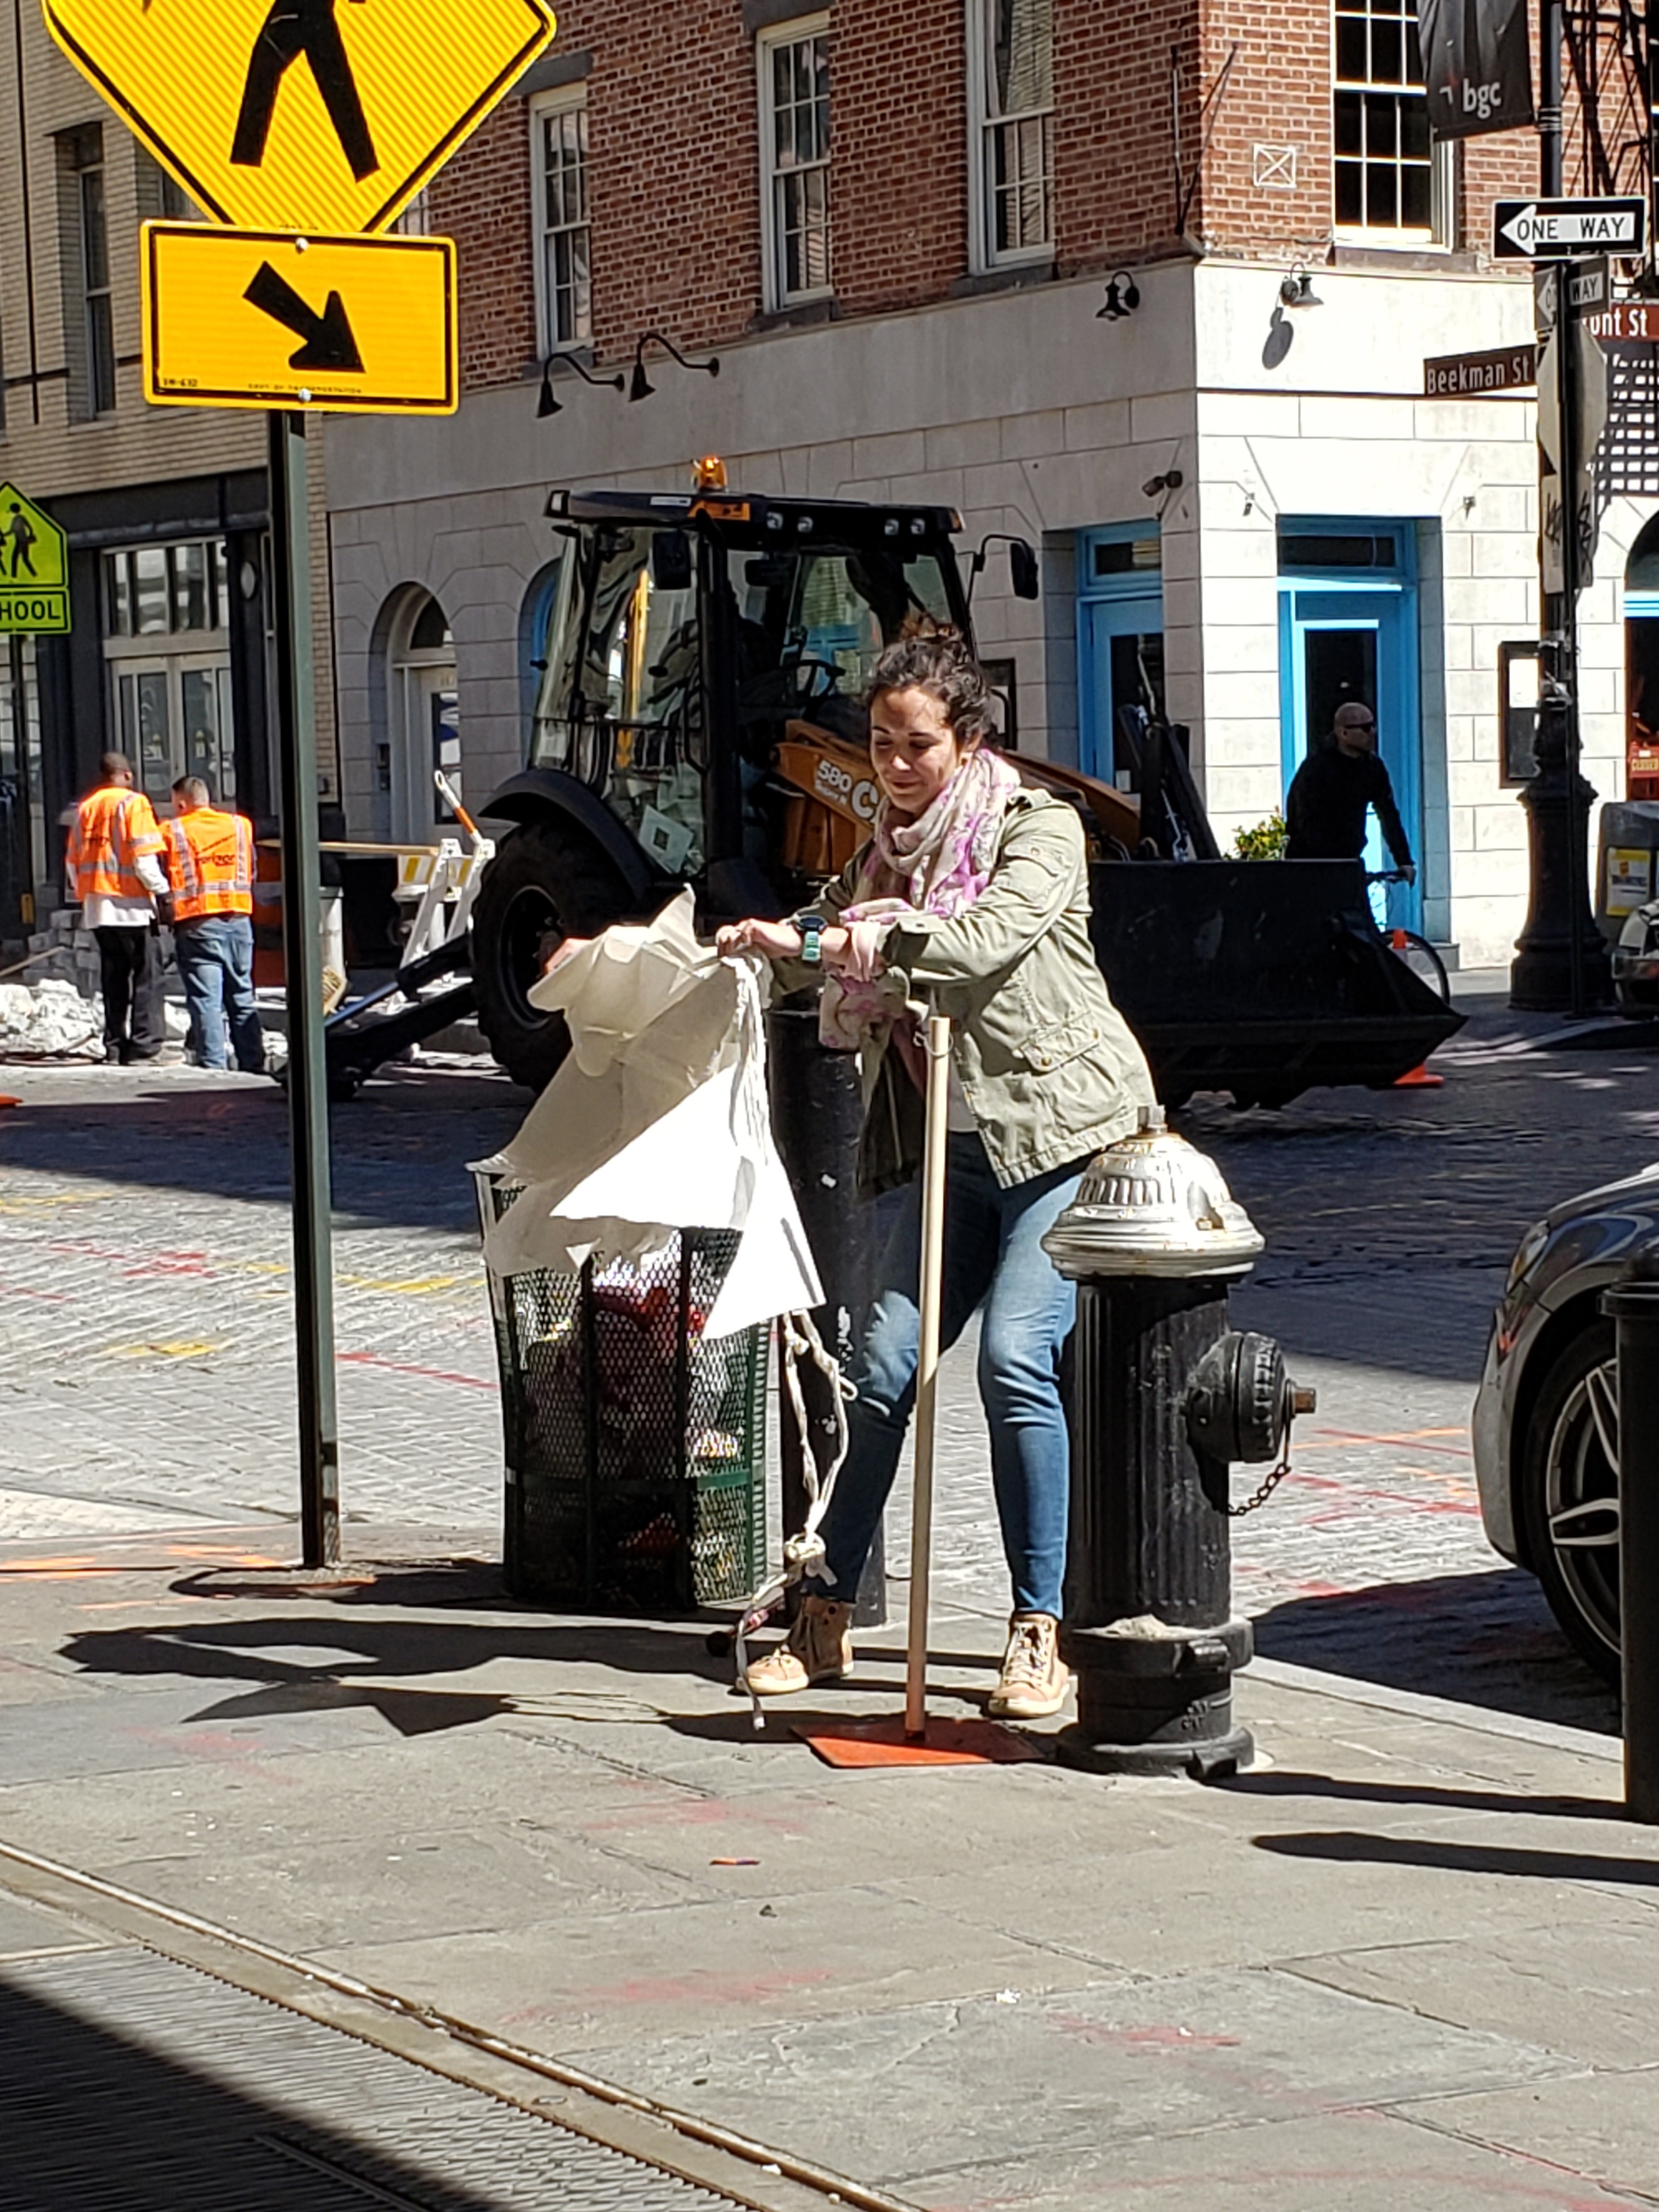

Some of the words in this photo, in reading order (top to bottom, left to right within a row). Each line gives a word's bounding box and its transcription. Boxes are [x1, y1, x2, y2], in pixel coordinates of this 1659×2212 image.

[1463, 77, 1502, 119] bgc
[1517, 218, 1559, 241] ONE
[1580, 217, 1626, 239] WAY
[1572, 276, 1599, 302] WAY
[1582, 307, 1622, 336] ont
[1628, 308, 1648, 337] St
[1427, 362, 1505, 394] Beekman
[1512, 354, 1530, 383] St
[0, 600, 61, 621] HOOL
[817, 759, 852, 793] 580
